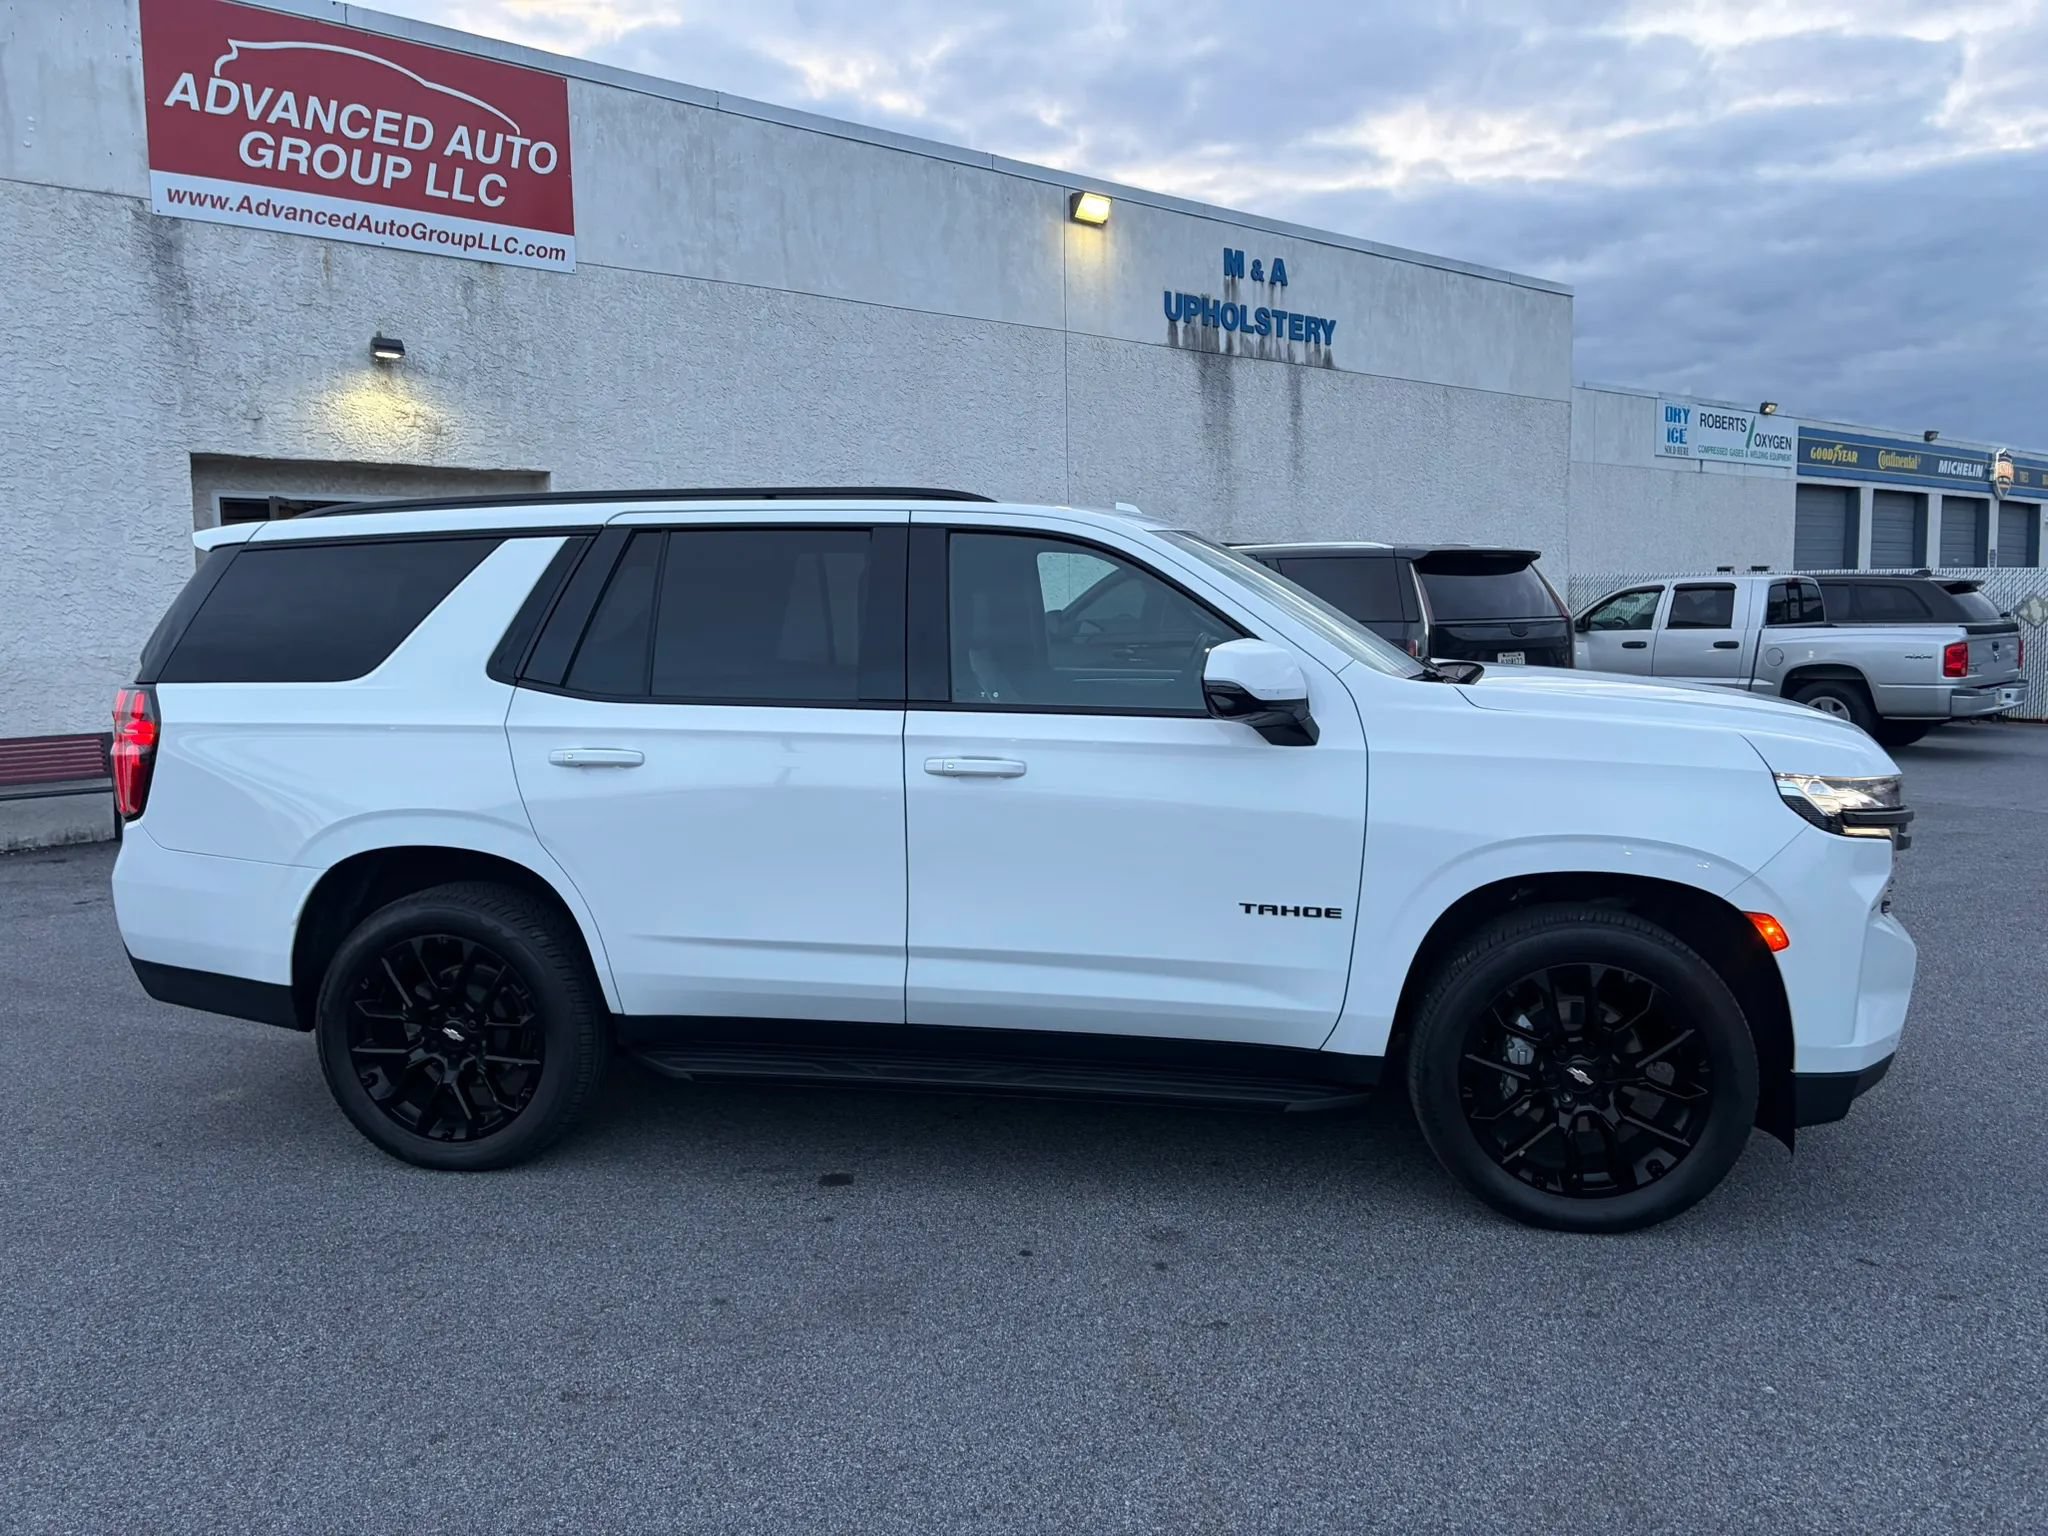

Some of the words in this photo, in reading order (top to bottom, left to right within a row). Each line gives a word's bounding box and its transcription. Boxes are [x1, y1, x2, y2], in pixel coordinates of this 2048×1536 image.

[164, 72, 434, 151] ADVANCED
[443, 125, 558, 174] AUTO
[239, 131, 412, 189] GROUP
[425, 162, 508, 207] LLC
[167, 187, 566, 261] www.AdvancedAutoGroupLLC.com
[1223, 247, 1245, 279] M
[1250, 258, 1265, 283] &
[1269, 257, 1288, 287] A
[1164, 290, 1337, 346] UPHOLSTERY
[1664, 405, 1690, 425] DRY
[1699, 413, 1747, 433] ROBERTS
[1667, 427, 1687, 445] ICE
[1754, 432, 1792, 451] OXYGEN
[1810, 444, 1858, 464] GOODYEAR
[1938, 459, 1984, 478] MICHELIN
[1238, 902, 1343, 919] TAHOE
